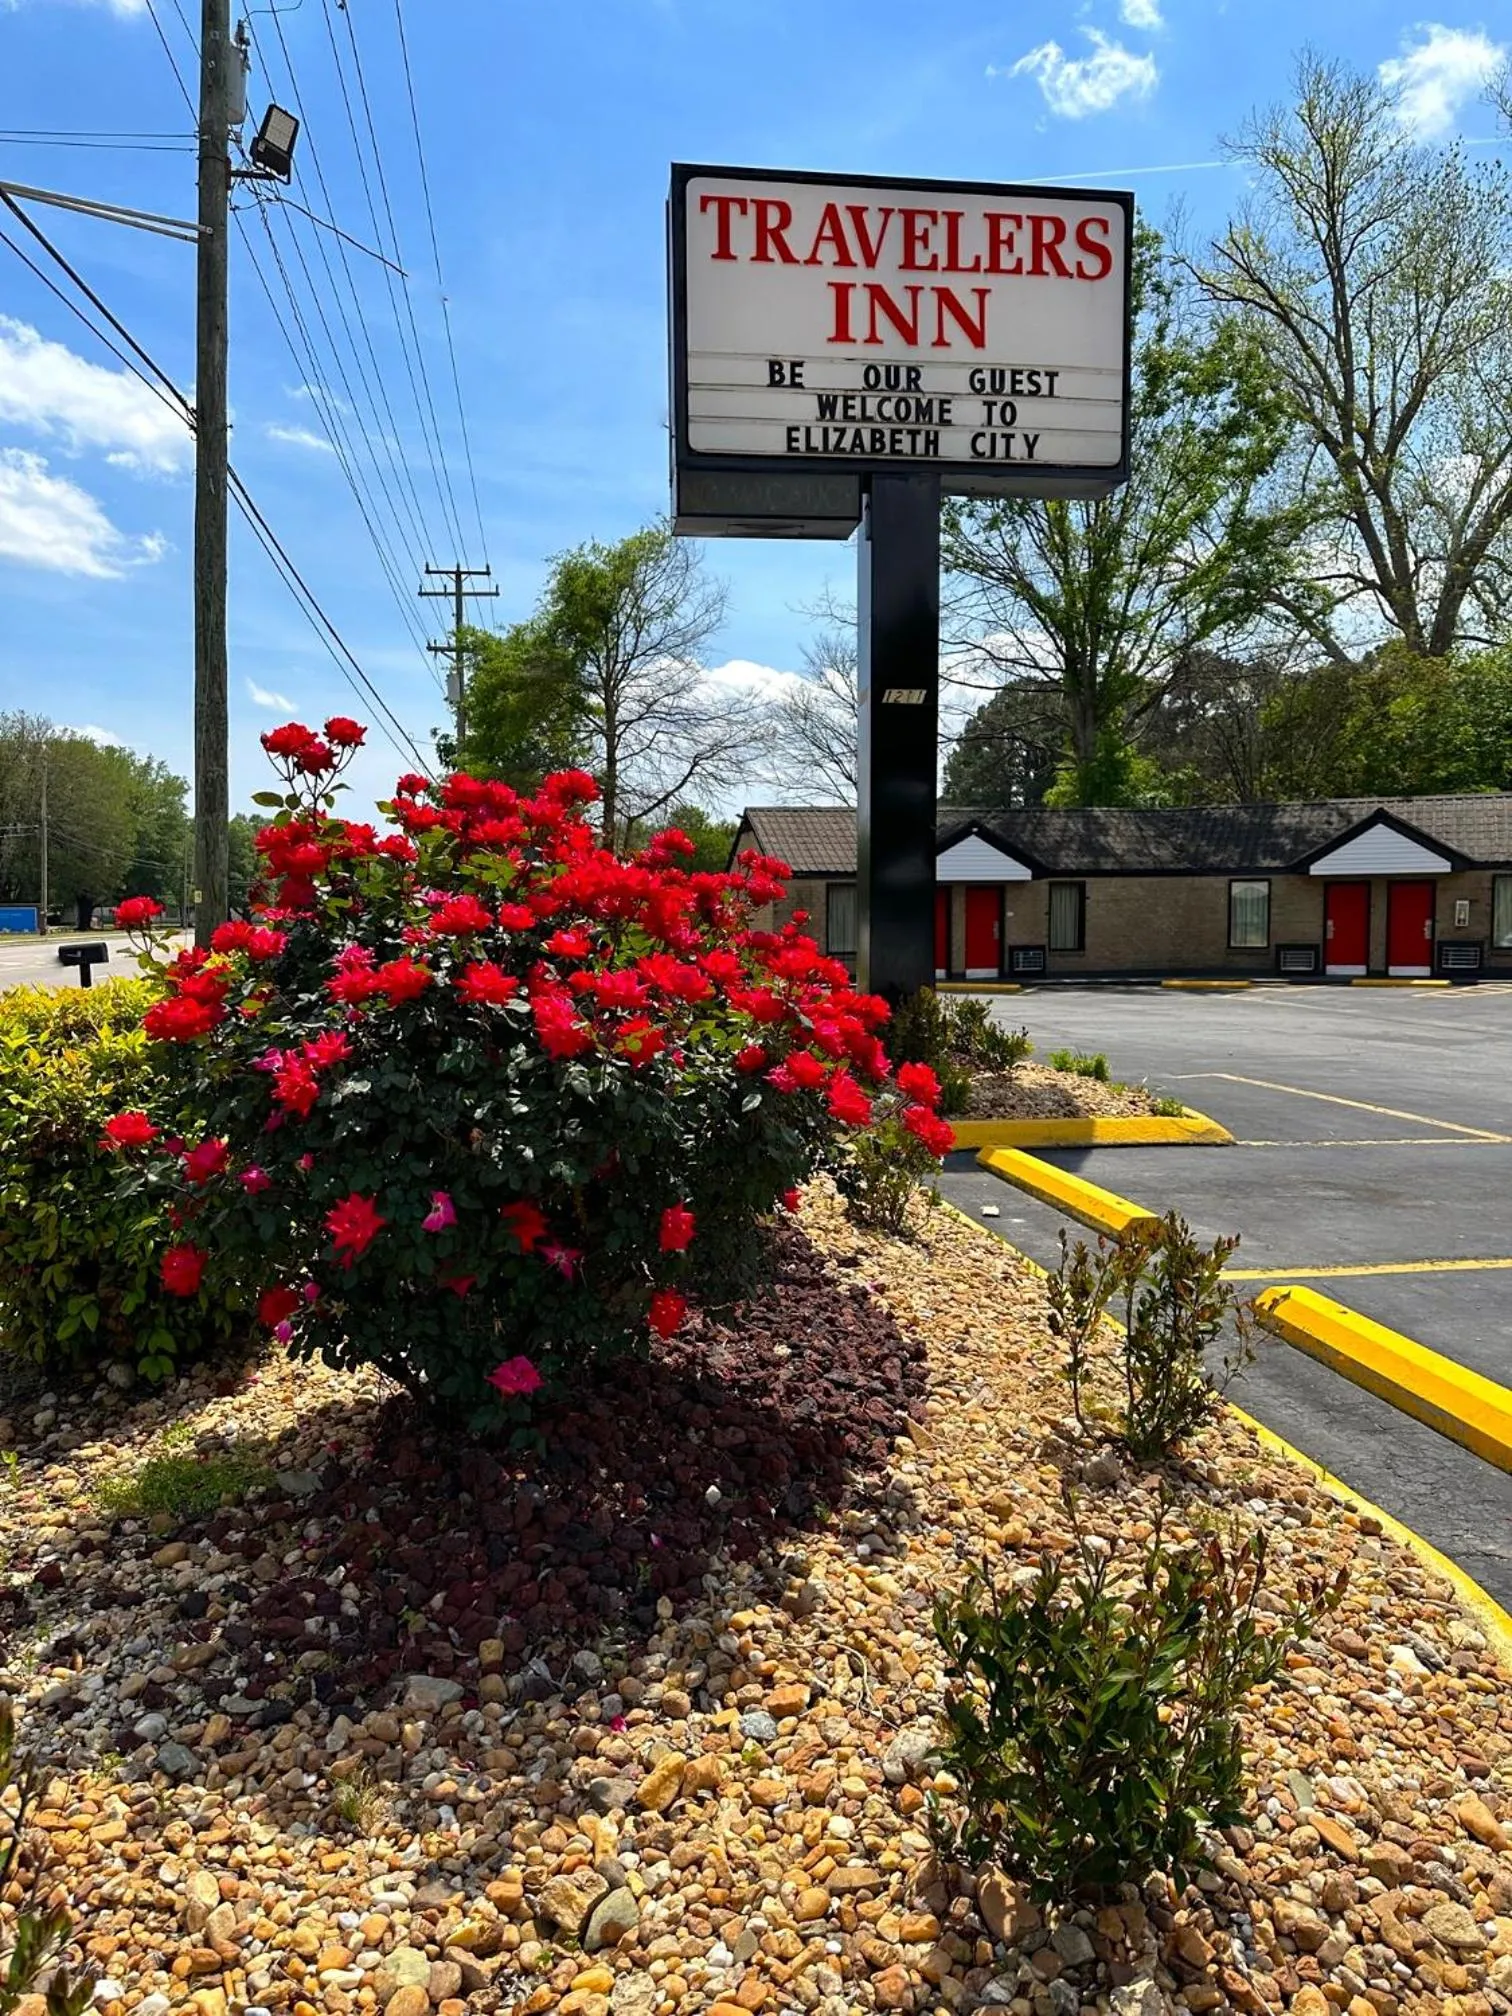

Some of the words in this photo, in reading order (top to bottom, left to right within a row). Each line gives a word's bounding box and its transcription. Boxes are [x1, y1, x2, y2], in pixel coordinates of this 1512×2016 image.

[700, 194, 1113, 281] TRAVELERS
[827, 281, 992, 349] INN
[768, 360, 804, 386] BE
[863, 364, 922, 392] OUR
[969, 368, 1059, 396] GUEST
[817, 394, 952, 424] WELCOME
[983, 401, 1017, 426] TO
[787, 426, 939, 455] ELIZABETH
[970, 432, 1040, 459] CITY
